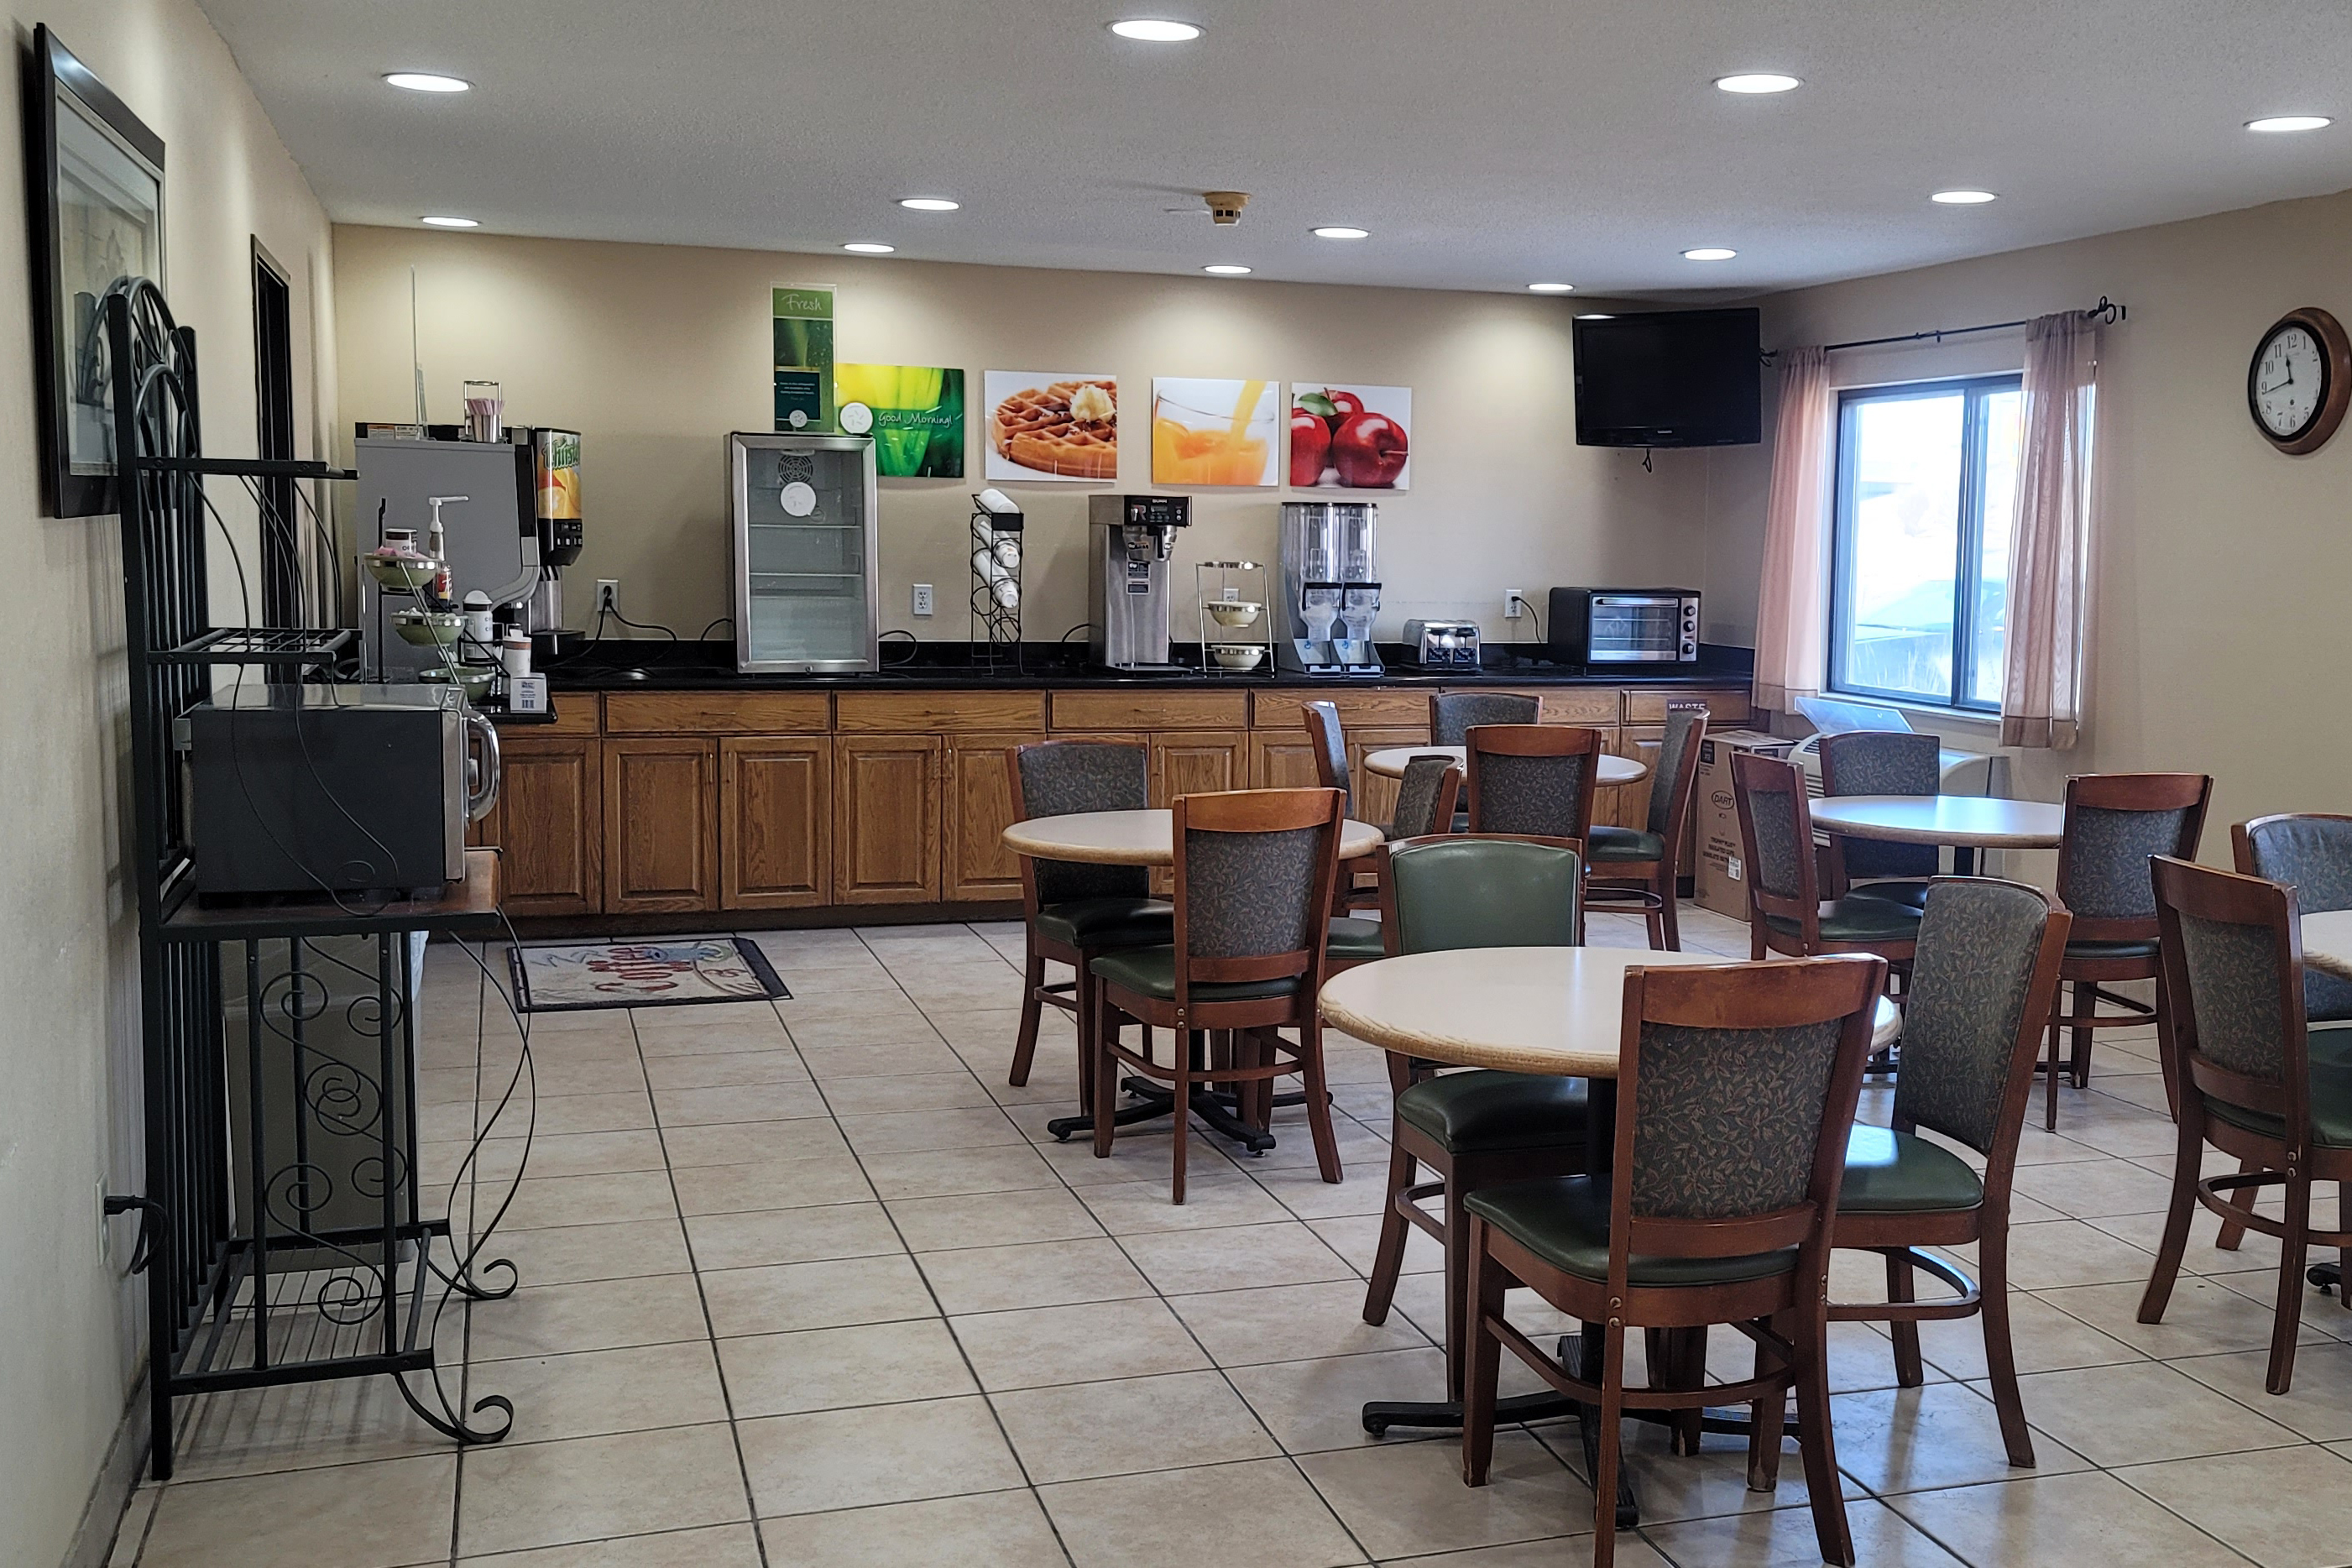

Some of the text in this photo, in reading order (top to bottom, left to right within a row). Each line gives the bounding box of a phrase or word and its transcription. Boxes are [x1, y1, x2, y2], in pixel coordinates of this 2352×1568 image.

[781, 293, 822, 311] Fresh
[2287, 333, 2297, 349] 12
[2302, 336, 2307, 349] 1
[2274, 343, 2281, 358] 11
[2265, 360, 2274, 375] 10
[2261, 381, 2268, 395] 9
[2266, 400, 2272, 415] 8
[878, 411, 954, 428] Good Morning!
[2276, 411, 2283, 426] 7
[2290, 415, 2297, 428] 6
[1714, 794, 1733, 807] DART
